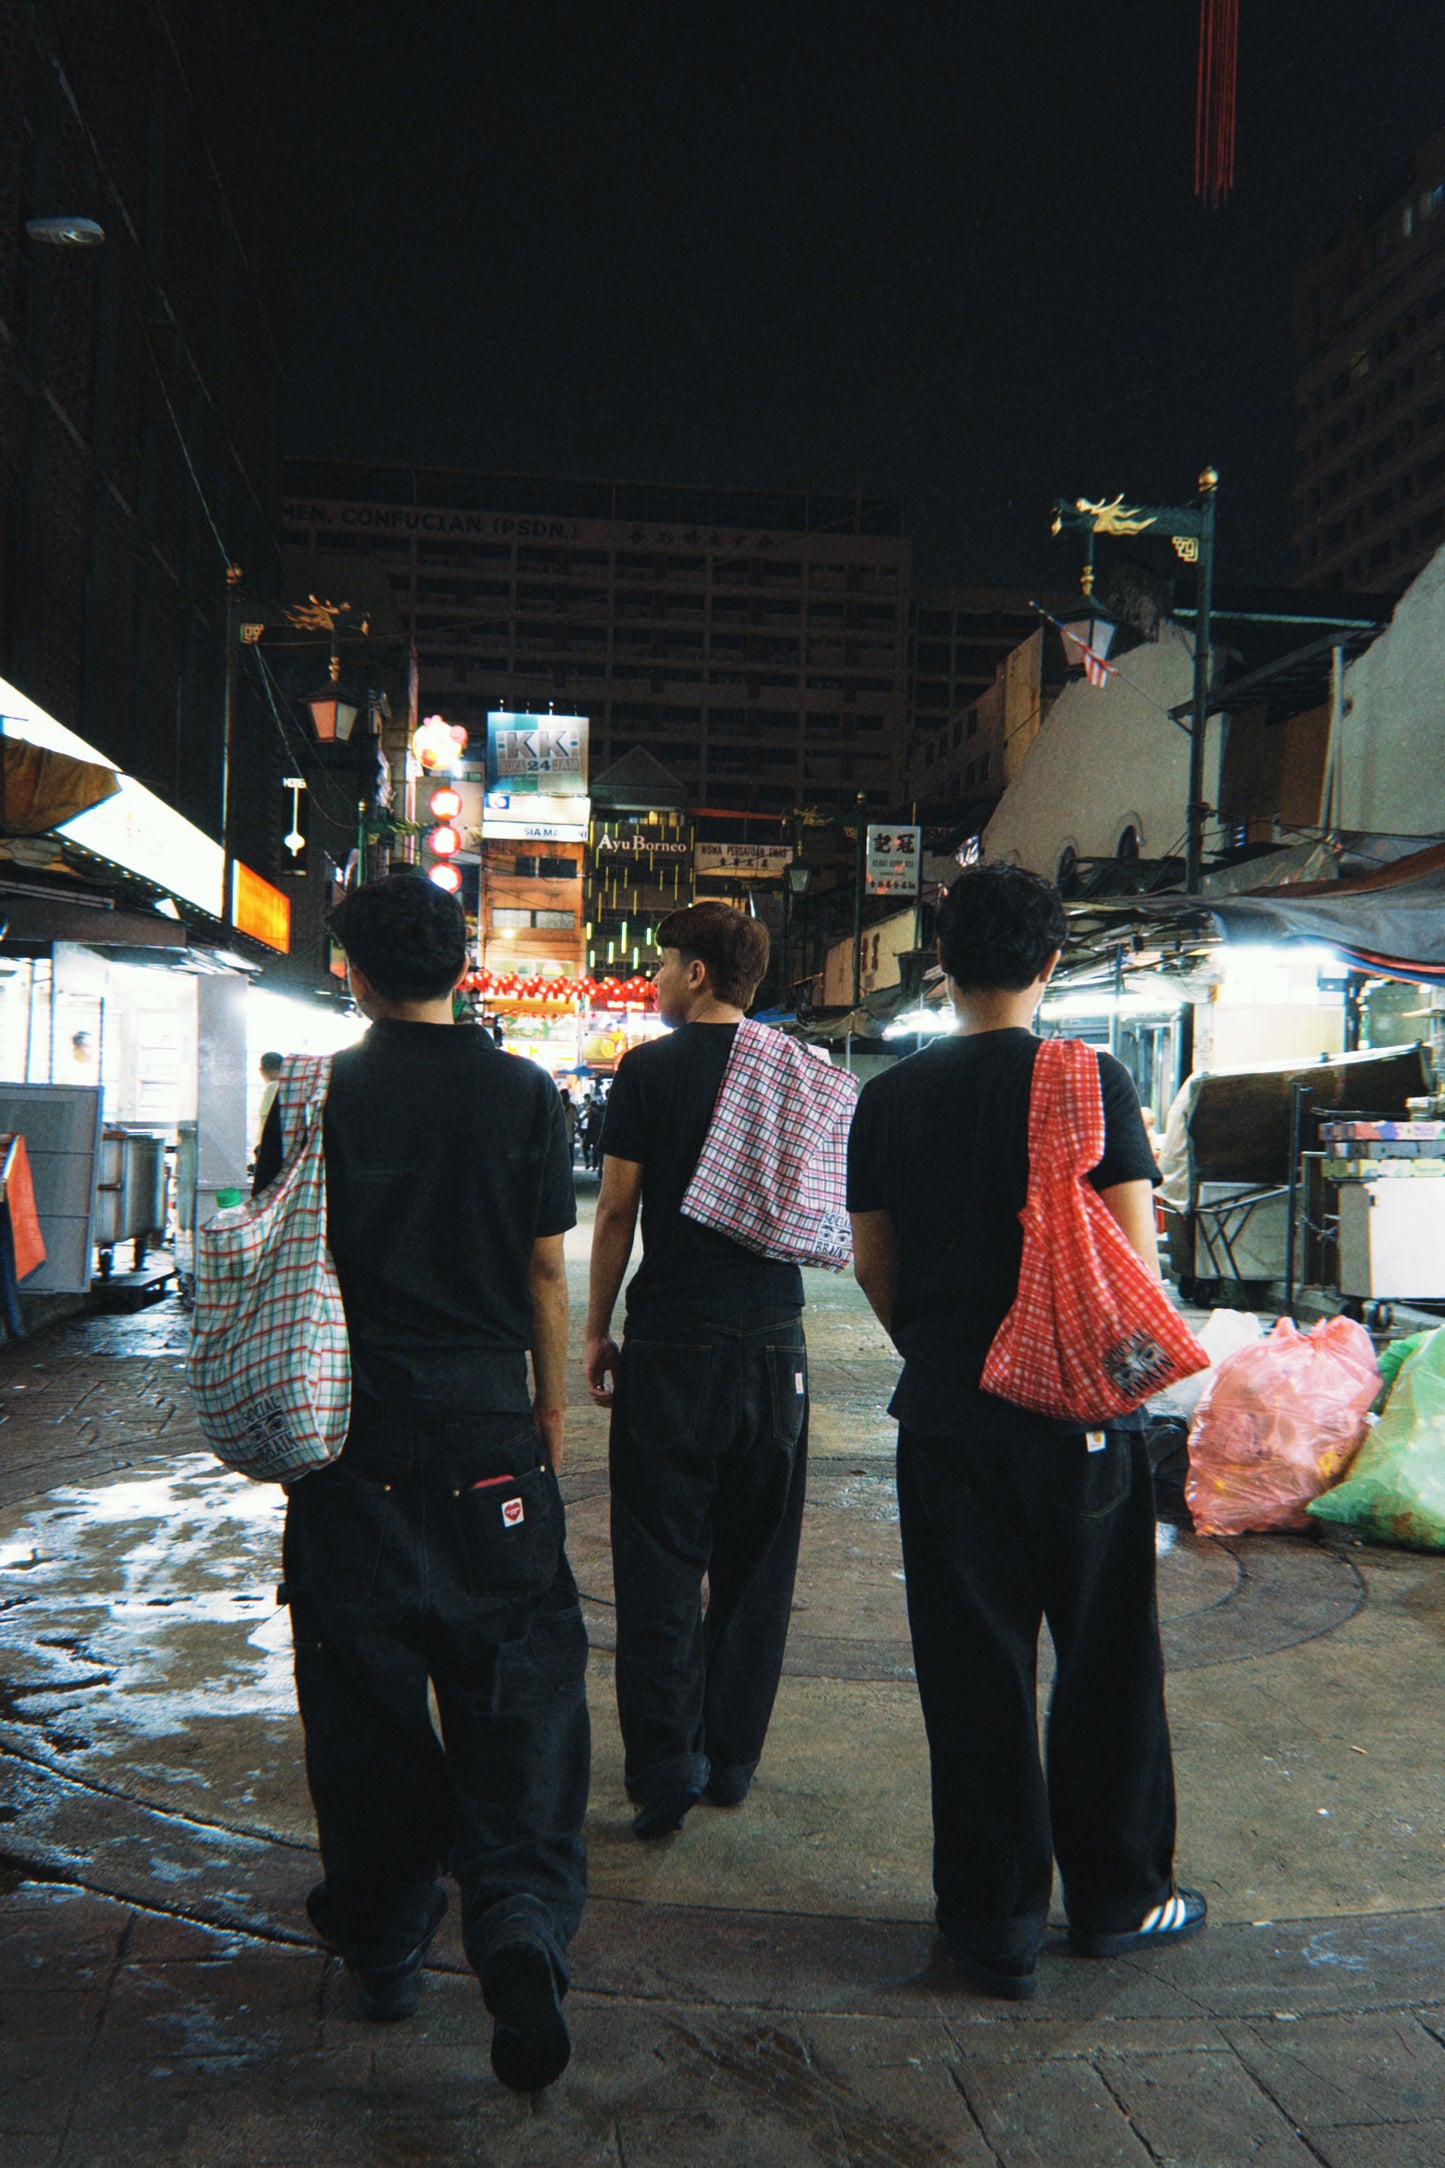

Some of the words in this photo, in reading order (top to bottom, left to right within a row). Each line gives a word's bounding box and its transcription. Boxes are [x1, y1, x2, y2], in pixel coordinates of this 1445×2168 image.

[342, 507, 481, 533] CONFUCIAN
[507, 731, 569, 758] KK
[527, 760, 551, 771] 24
[552, 759, 579, 771] JAM
[598, 833, 631, 852] Ayu
[633, 834, 687, 853] Borneo
[701, 845, 722, 855] WISMA
[824, 1213, 852, 1229] SOCIA
[240, 1395, 282, 1426] SOCIAL
